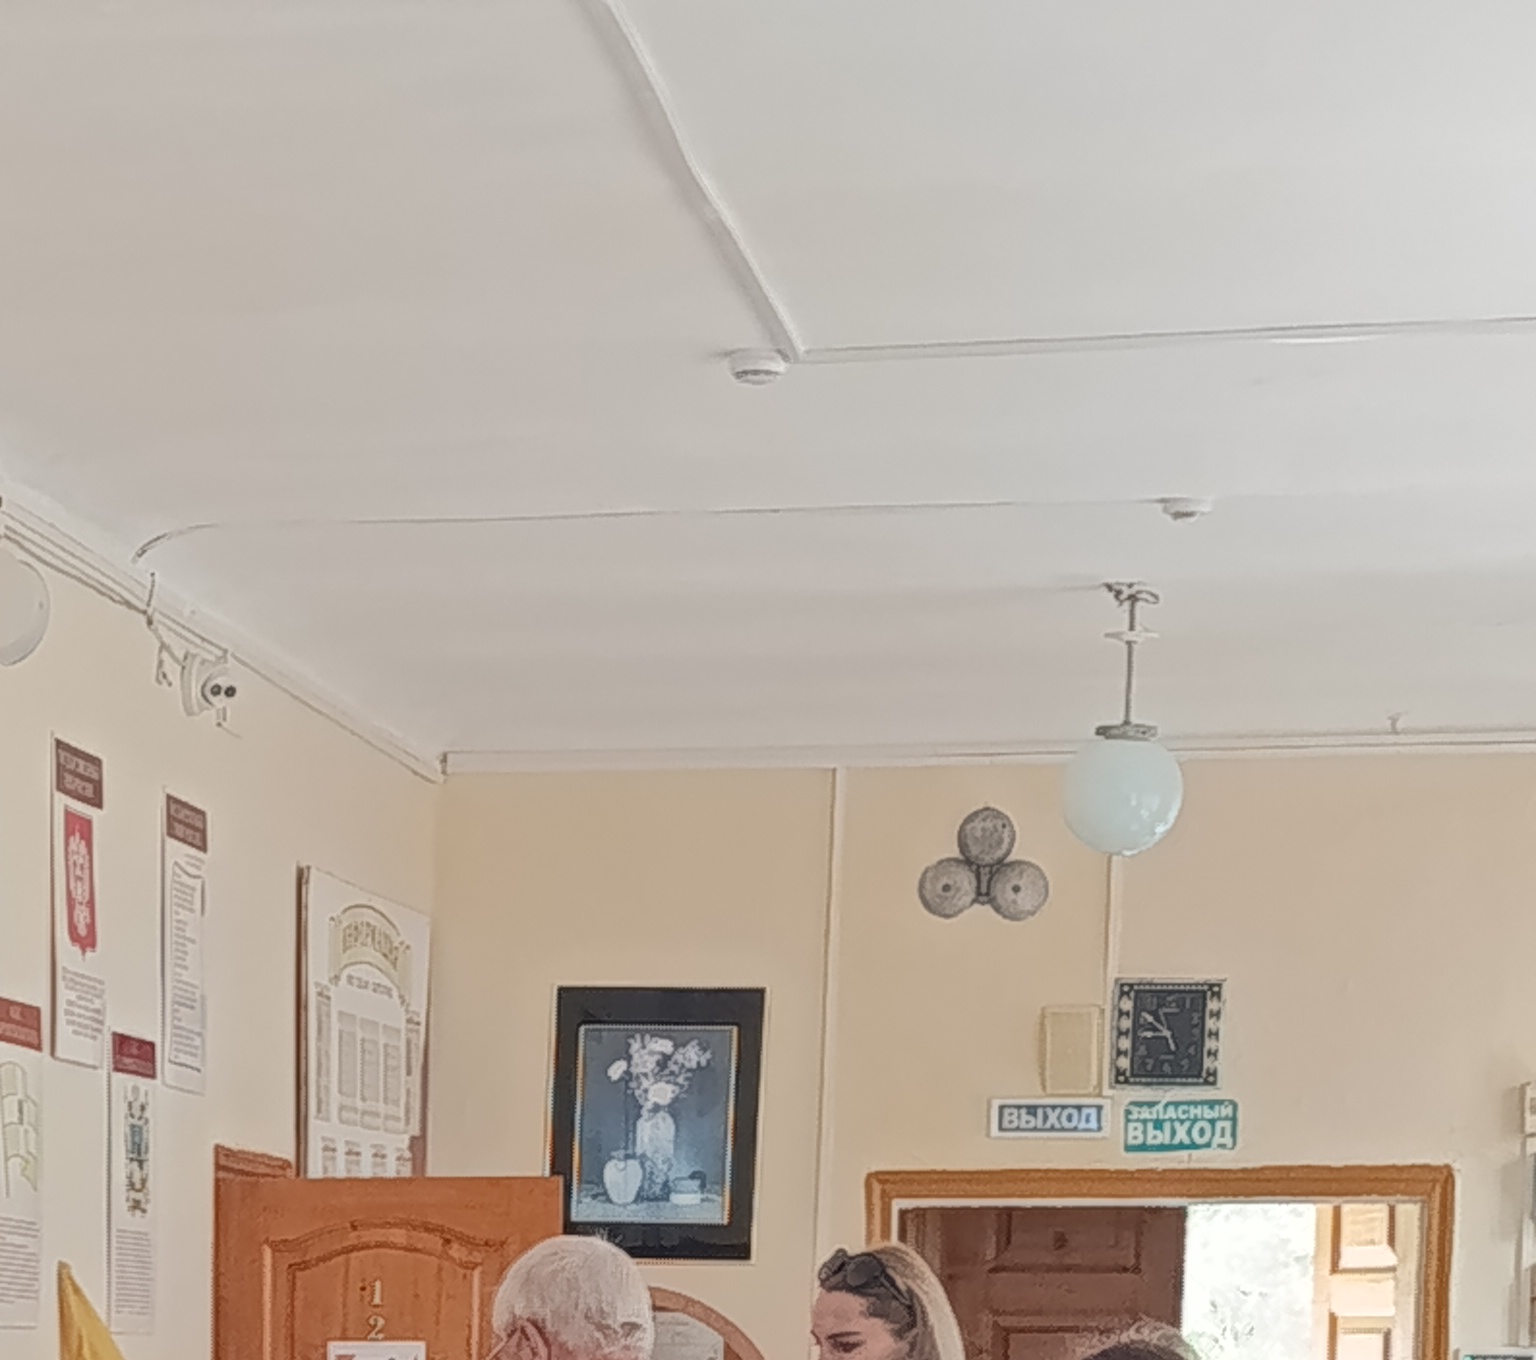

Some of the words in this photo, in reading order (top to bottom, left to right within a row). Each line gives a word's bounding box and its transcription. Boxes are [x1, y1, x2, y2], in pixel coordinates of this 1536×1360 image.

[1001, 1106, 1099, 1131] ВЫХОД
[1127, 1101, 1234, 1120] ЗАПАСНЫЙ
[1126, 1121, 1234, 1149] ВЫХОД
[369, 1279, 384, 1307] 1
[367, 1315, 385, 1340] 2
